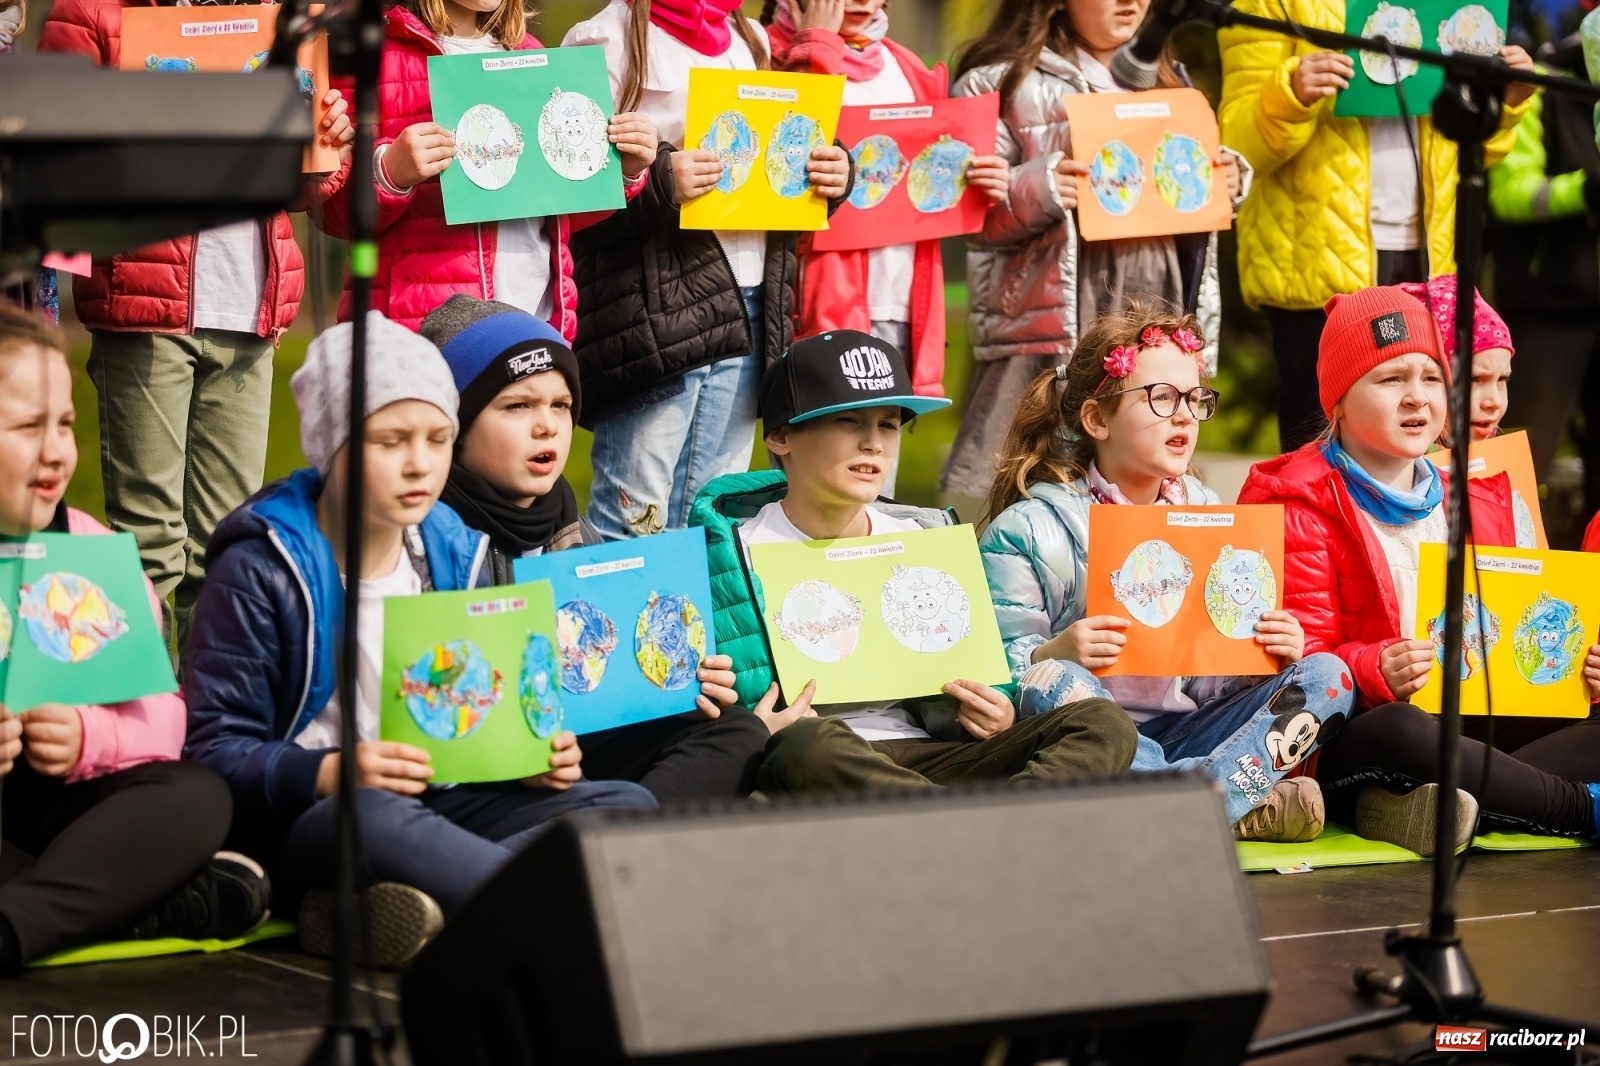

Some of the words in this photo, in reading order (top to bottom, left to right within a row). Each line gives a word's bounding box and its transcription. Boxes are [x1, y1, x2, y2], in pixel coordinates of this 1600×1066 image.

[519, 58, 525, 66] 22
[839, 346, 893, 378] WOJAN
[855, 377, 893, 390] TEAM
[1168, 515, 1183, 523] Dzień
[1184, 515, 1199, 523] Ziemi
[1211, 515, 1232, 523] kwietnia
[828, 551, 846, 559] Dzień
[846, 550, 863, 558] Ziemi
[878, 544, 903, 554] kwietnia
[1477, 558, 1492, 567] Dzień
[1492, 559, 1506, 568] Ziemi
[1518, 563, 1540, 571] kwietnia
[1235, 753, 1272, 791] Mickey
[1227, 770, 1260, 805] Mouse
